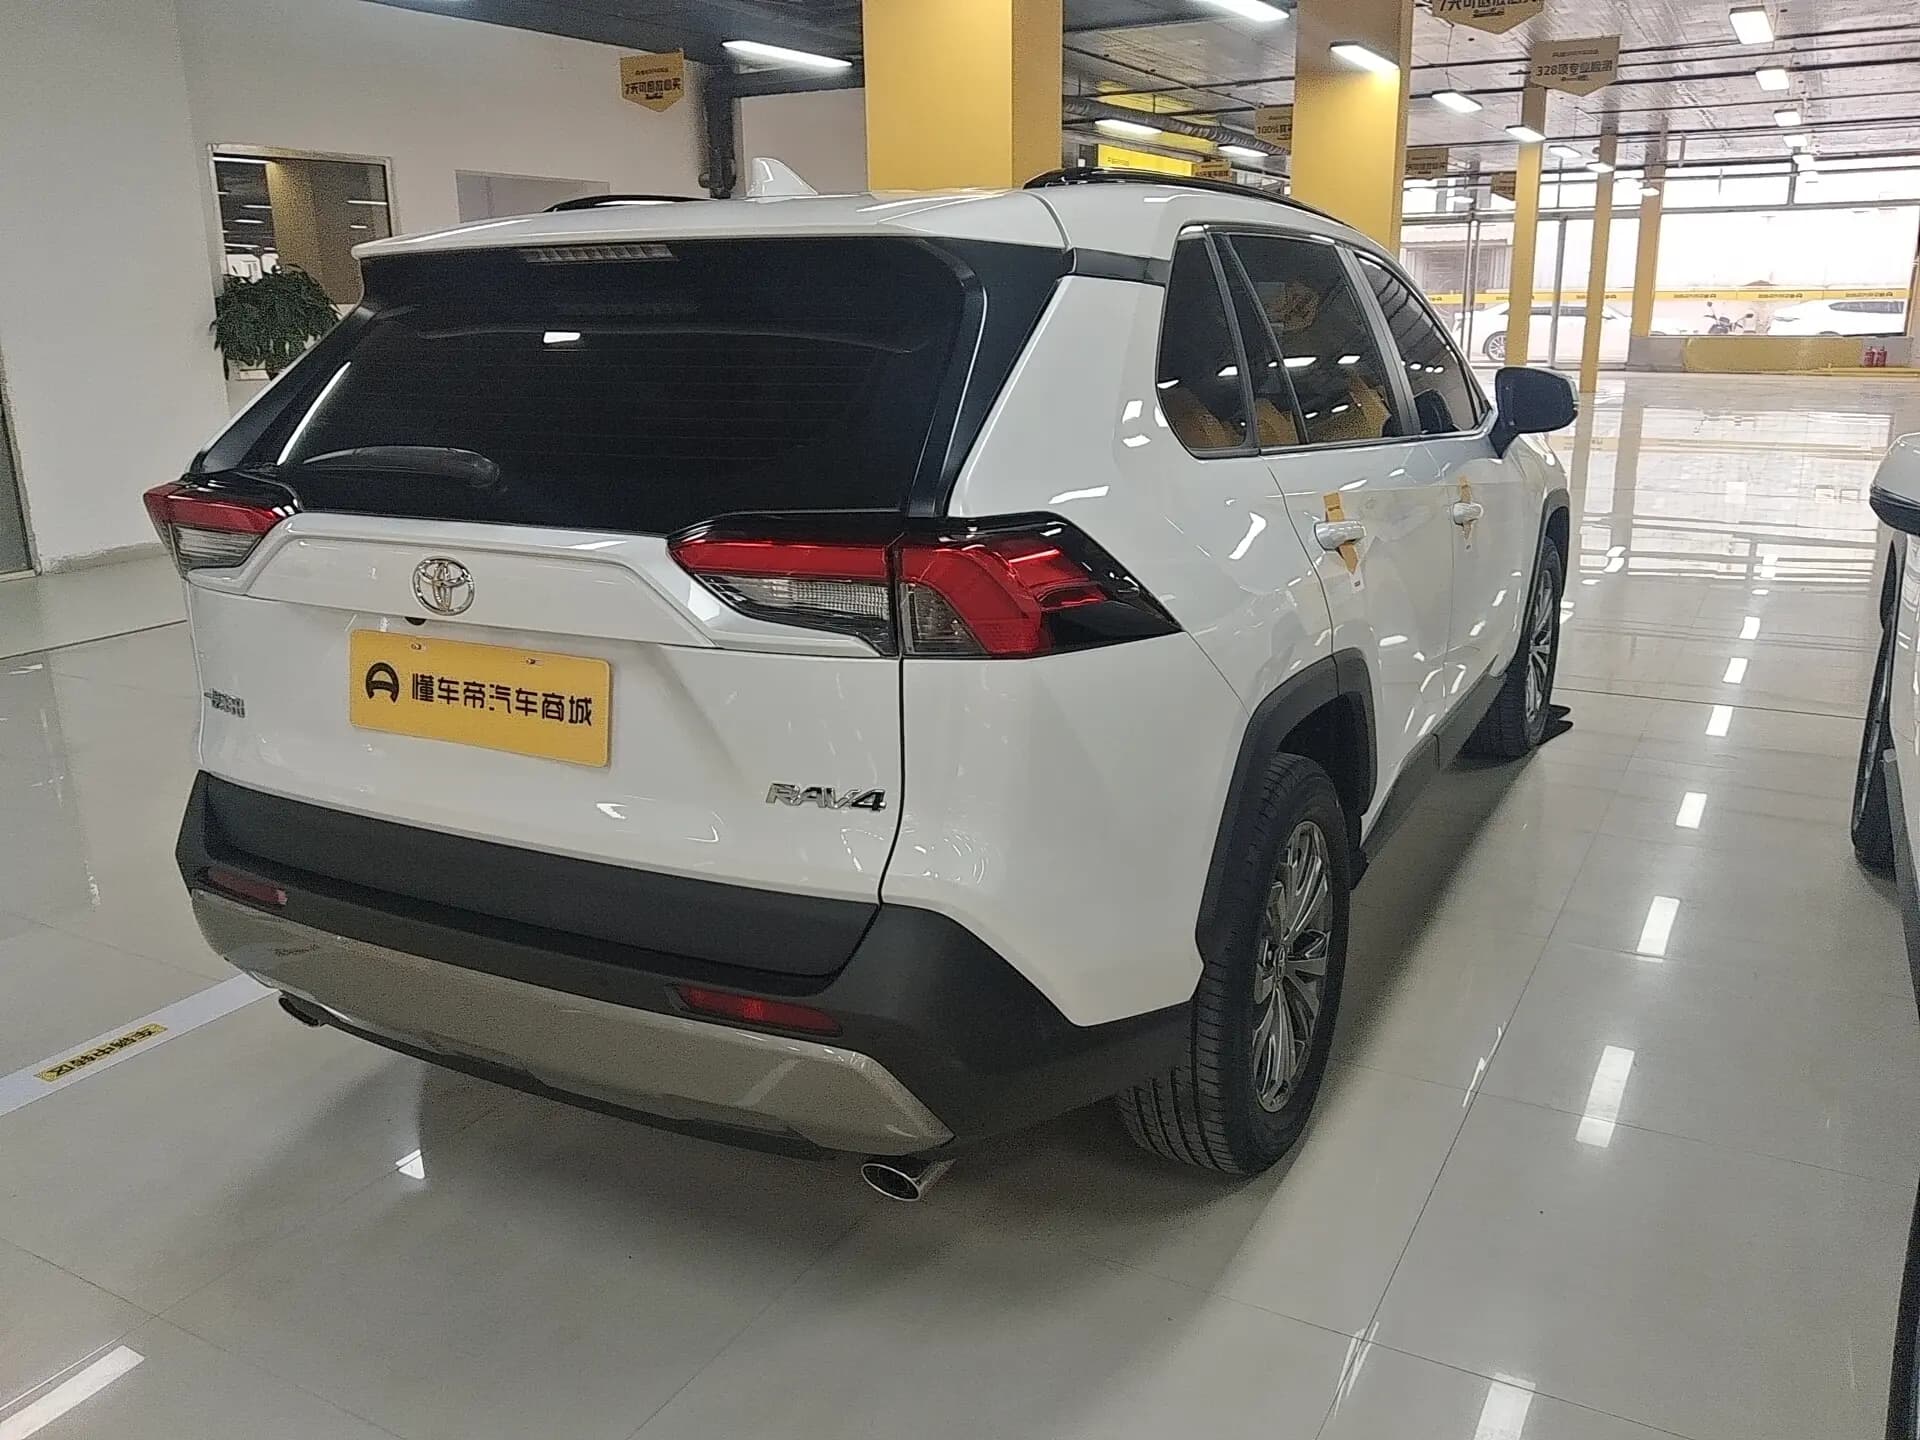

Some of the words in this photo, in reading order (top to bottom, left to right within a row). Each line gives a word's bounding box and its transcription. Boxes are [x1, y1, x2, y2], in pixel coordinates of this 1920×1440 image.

[412, 673, 593, 726] 懂车帝汽车商城
[766, 782, 886, 811] RAV4
